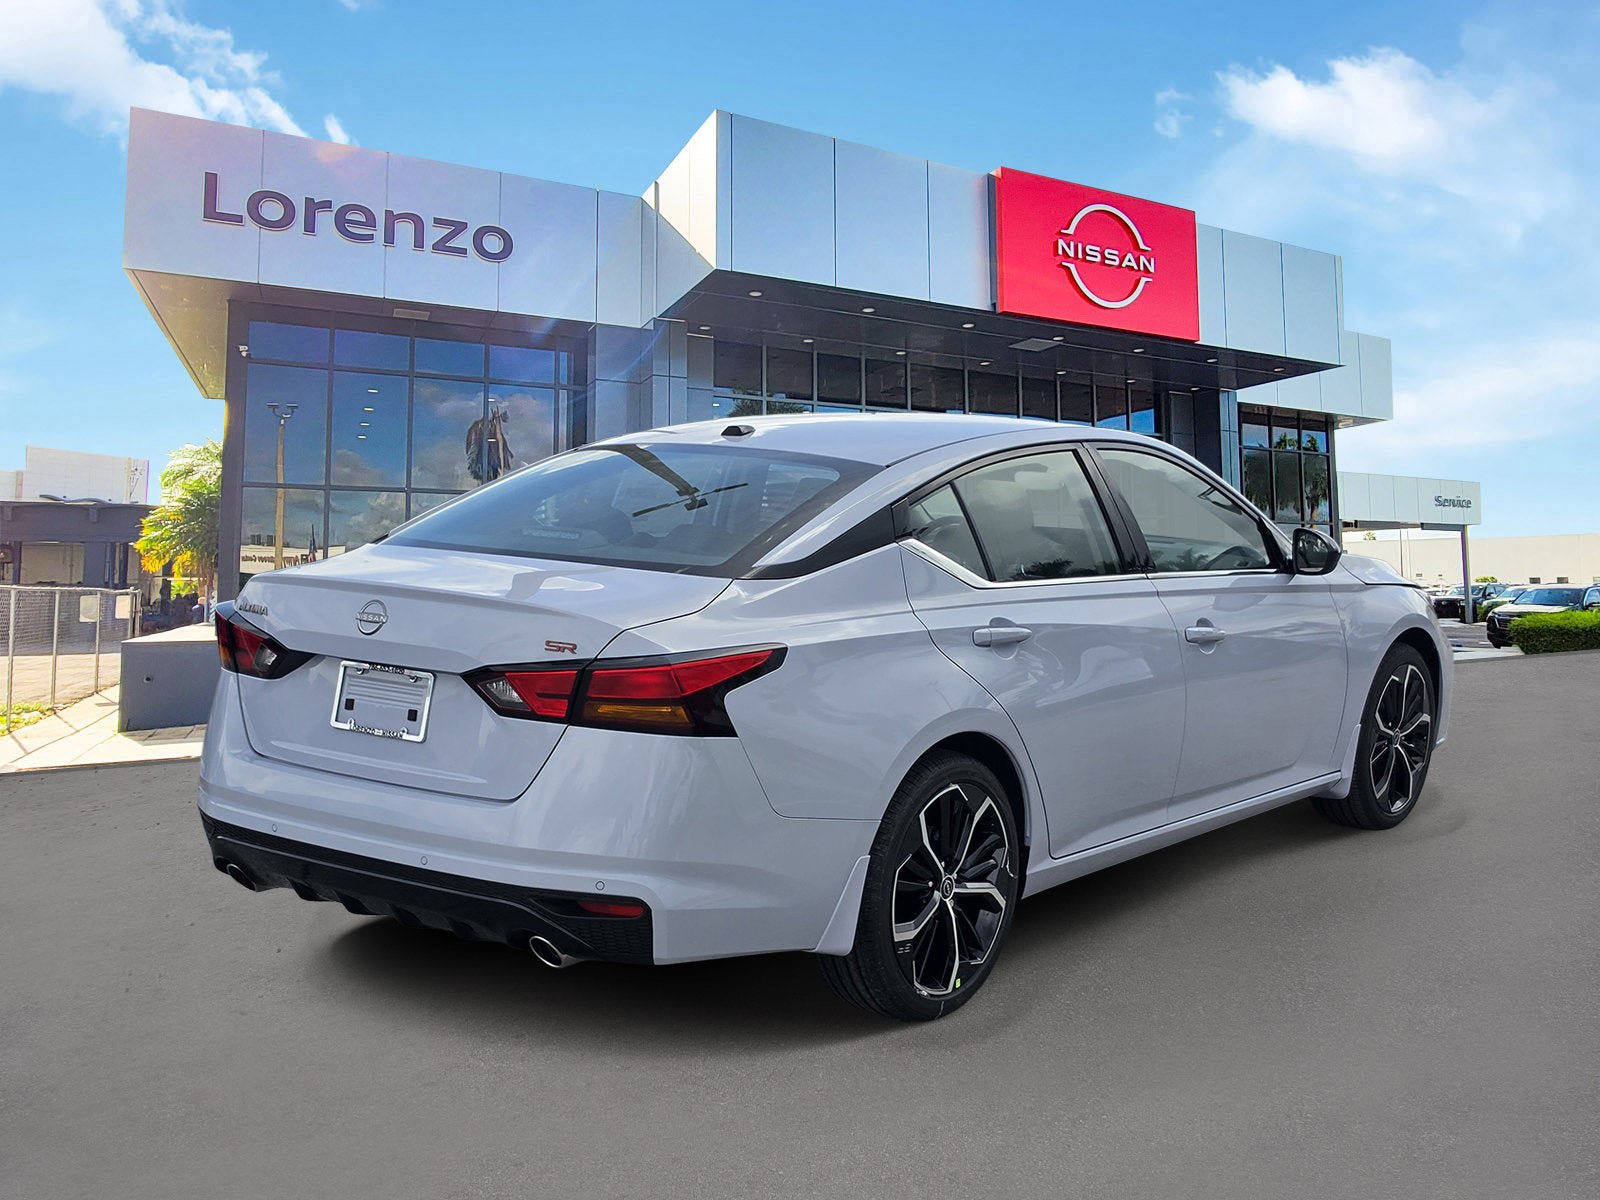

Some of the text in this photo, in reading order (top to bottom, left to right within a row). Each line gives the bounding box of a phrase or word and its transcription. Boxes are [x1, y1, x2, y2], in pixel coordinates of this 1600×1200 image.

[202, 171, 514, 263] Lorenzo
[1057, 238, 1155, 273] NISSAN
[1434, 495, 1472, 508] Service
[356, 612, 388, 623] NISSAN
[544, 640, 577, 655] SR
